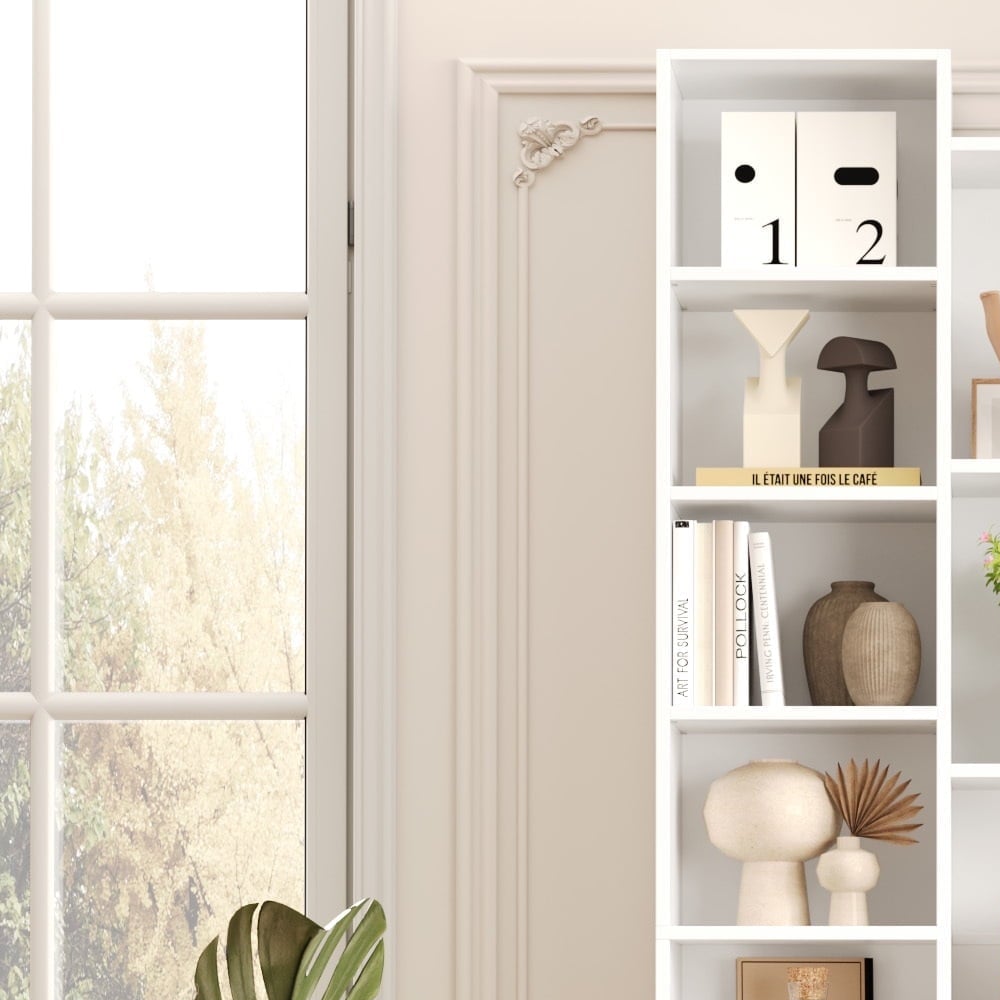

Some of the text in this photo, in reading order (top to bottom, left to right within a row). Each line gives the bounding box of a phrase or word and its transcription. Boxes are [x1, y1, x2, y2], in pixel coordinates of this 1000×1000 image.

[762, 218, 789, 265] 1
[856, 219, 886, 265] 2
[752, 471, 878, 486] IL ÉTAIT UNE FOIS LE CAFÉ
[756, 564, 769, 618] CENTENNIAL
[735, 573, 747, 659] POLLOCK
[677, 598, 689, 698] ART FOR SURVIVAL
[763, 650, 774, 683] IRVING
